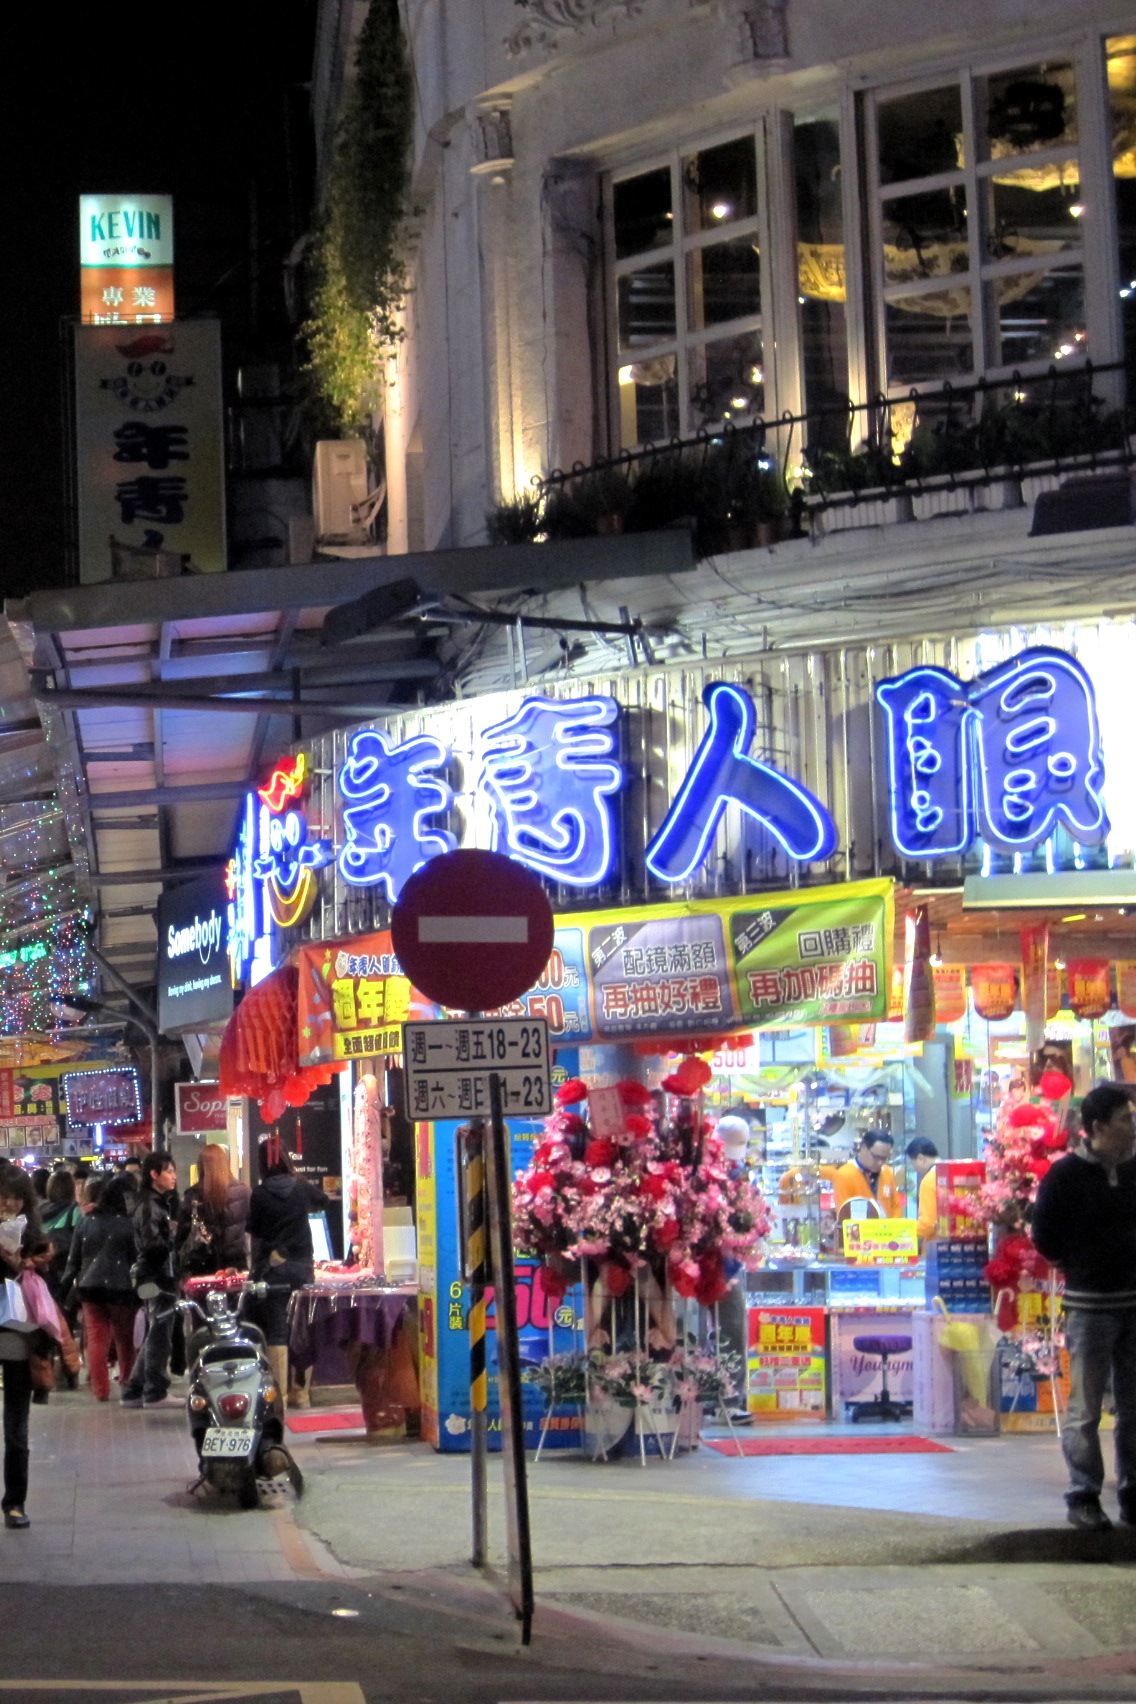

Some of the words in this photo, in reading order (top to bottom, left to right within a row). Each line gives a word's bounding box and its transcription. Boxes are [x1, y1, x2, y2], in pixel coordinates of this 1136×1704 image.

[90, 210, 161, 242] KEVIN
[102, 285, 156, 307] 專業
[167, 909, 222, 959] Somebody
[590, 924, 628, 969] 第二波
[733, 910, 777, 956] 第三波
[797, 922, 875, 960] 回購禮
[622, 941, 717, 978] 配鏡滿額
[601, 974, 723, 1021] 再抽好禮
[747, 957, 879, 1008] 再加碼抽
